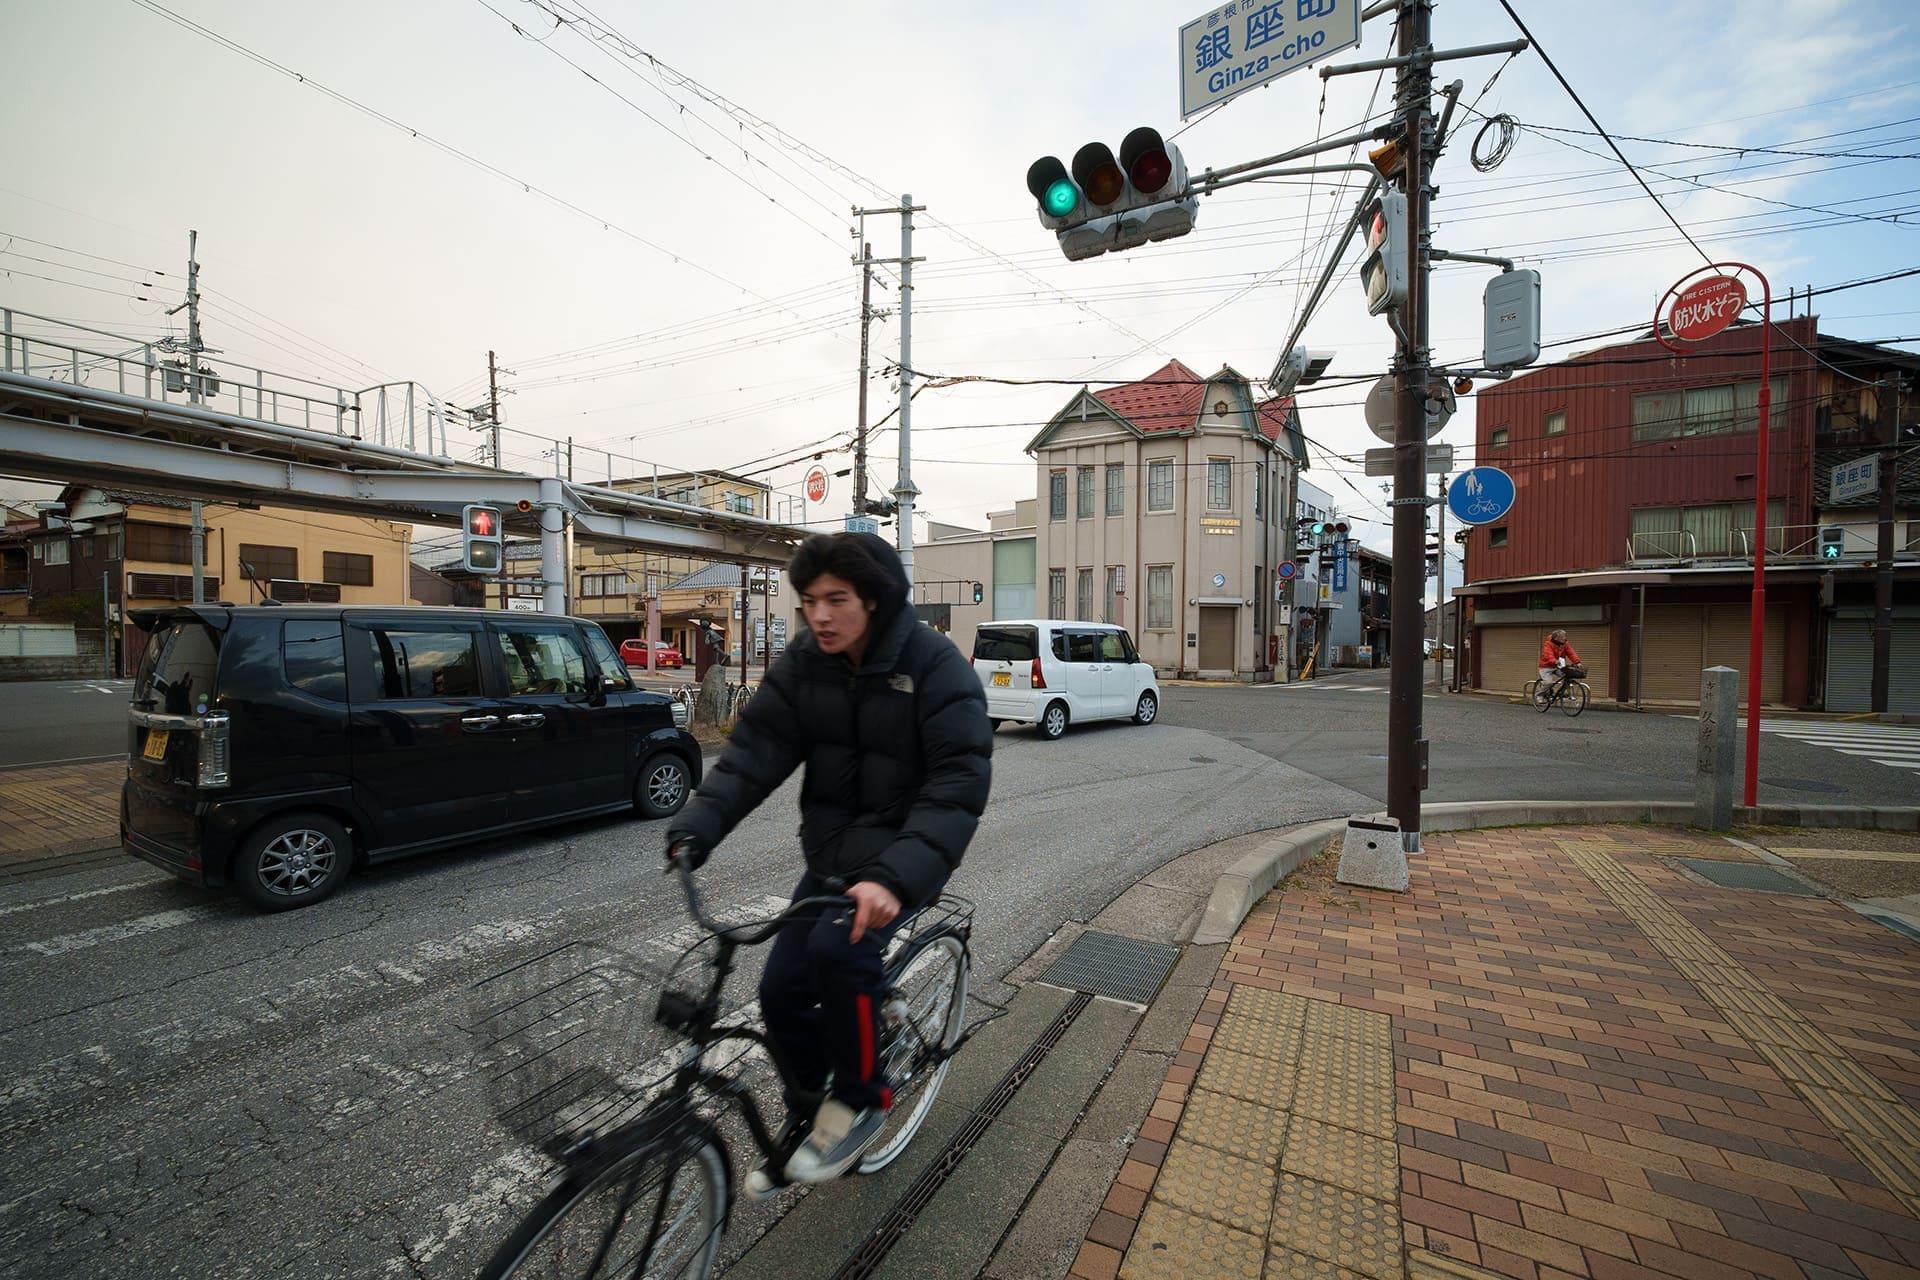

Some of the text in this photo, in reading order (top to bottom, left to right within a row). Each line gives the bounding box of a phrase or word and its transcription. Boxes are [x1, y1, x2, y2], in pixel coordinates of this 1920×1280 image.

[1195, 0, 1336, 74] 銀座町
[1208, 30, 1325, 94] Ginza-cho
[1674, 291, 1741, 332] 防火水そう
[1682, 281, 1731, 302] FIRE CISTERN
[1835, 463, 1873, 487] 銀座町
